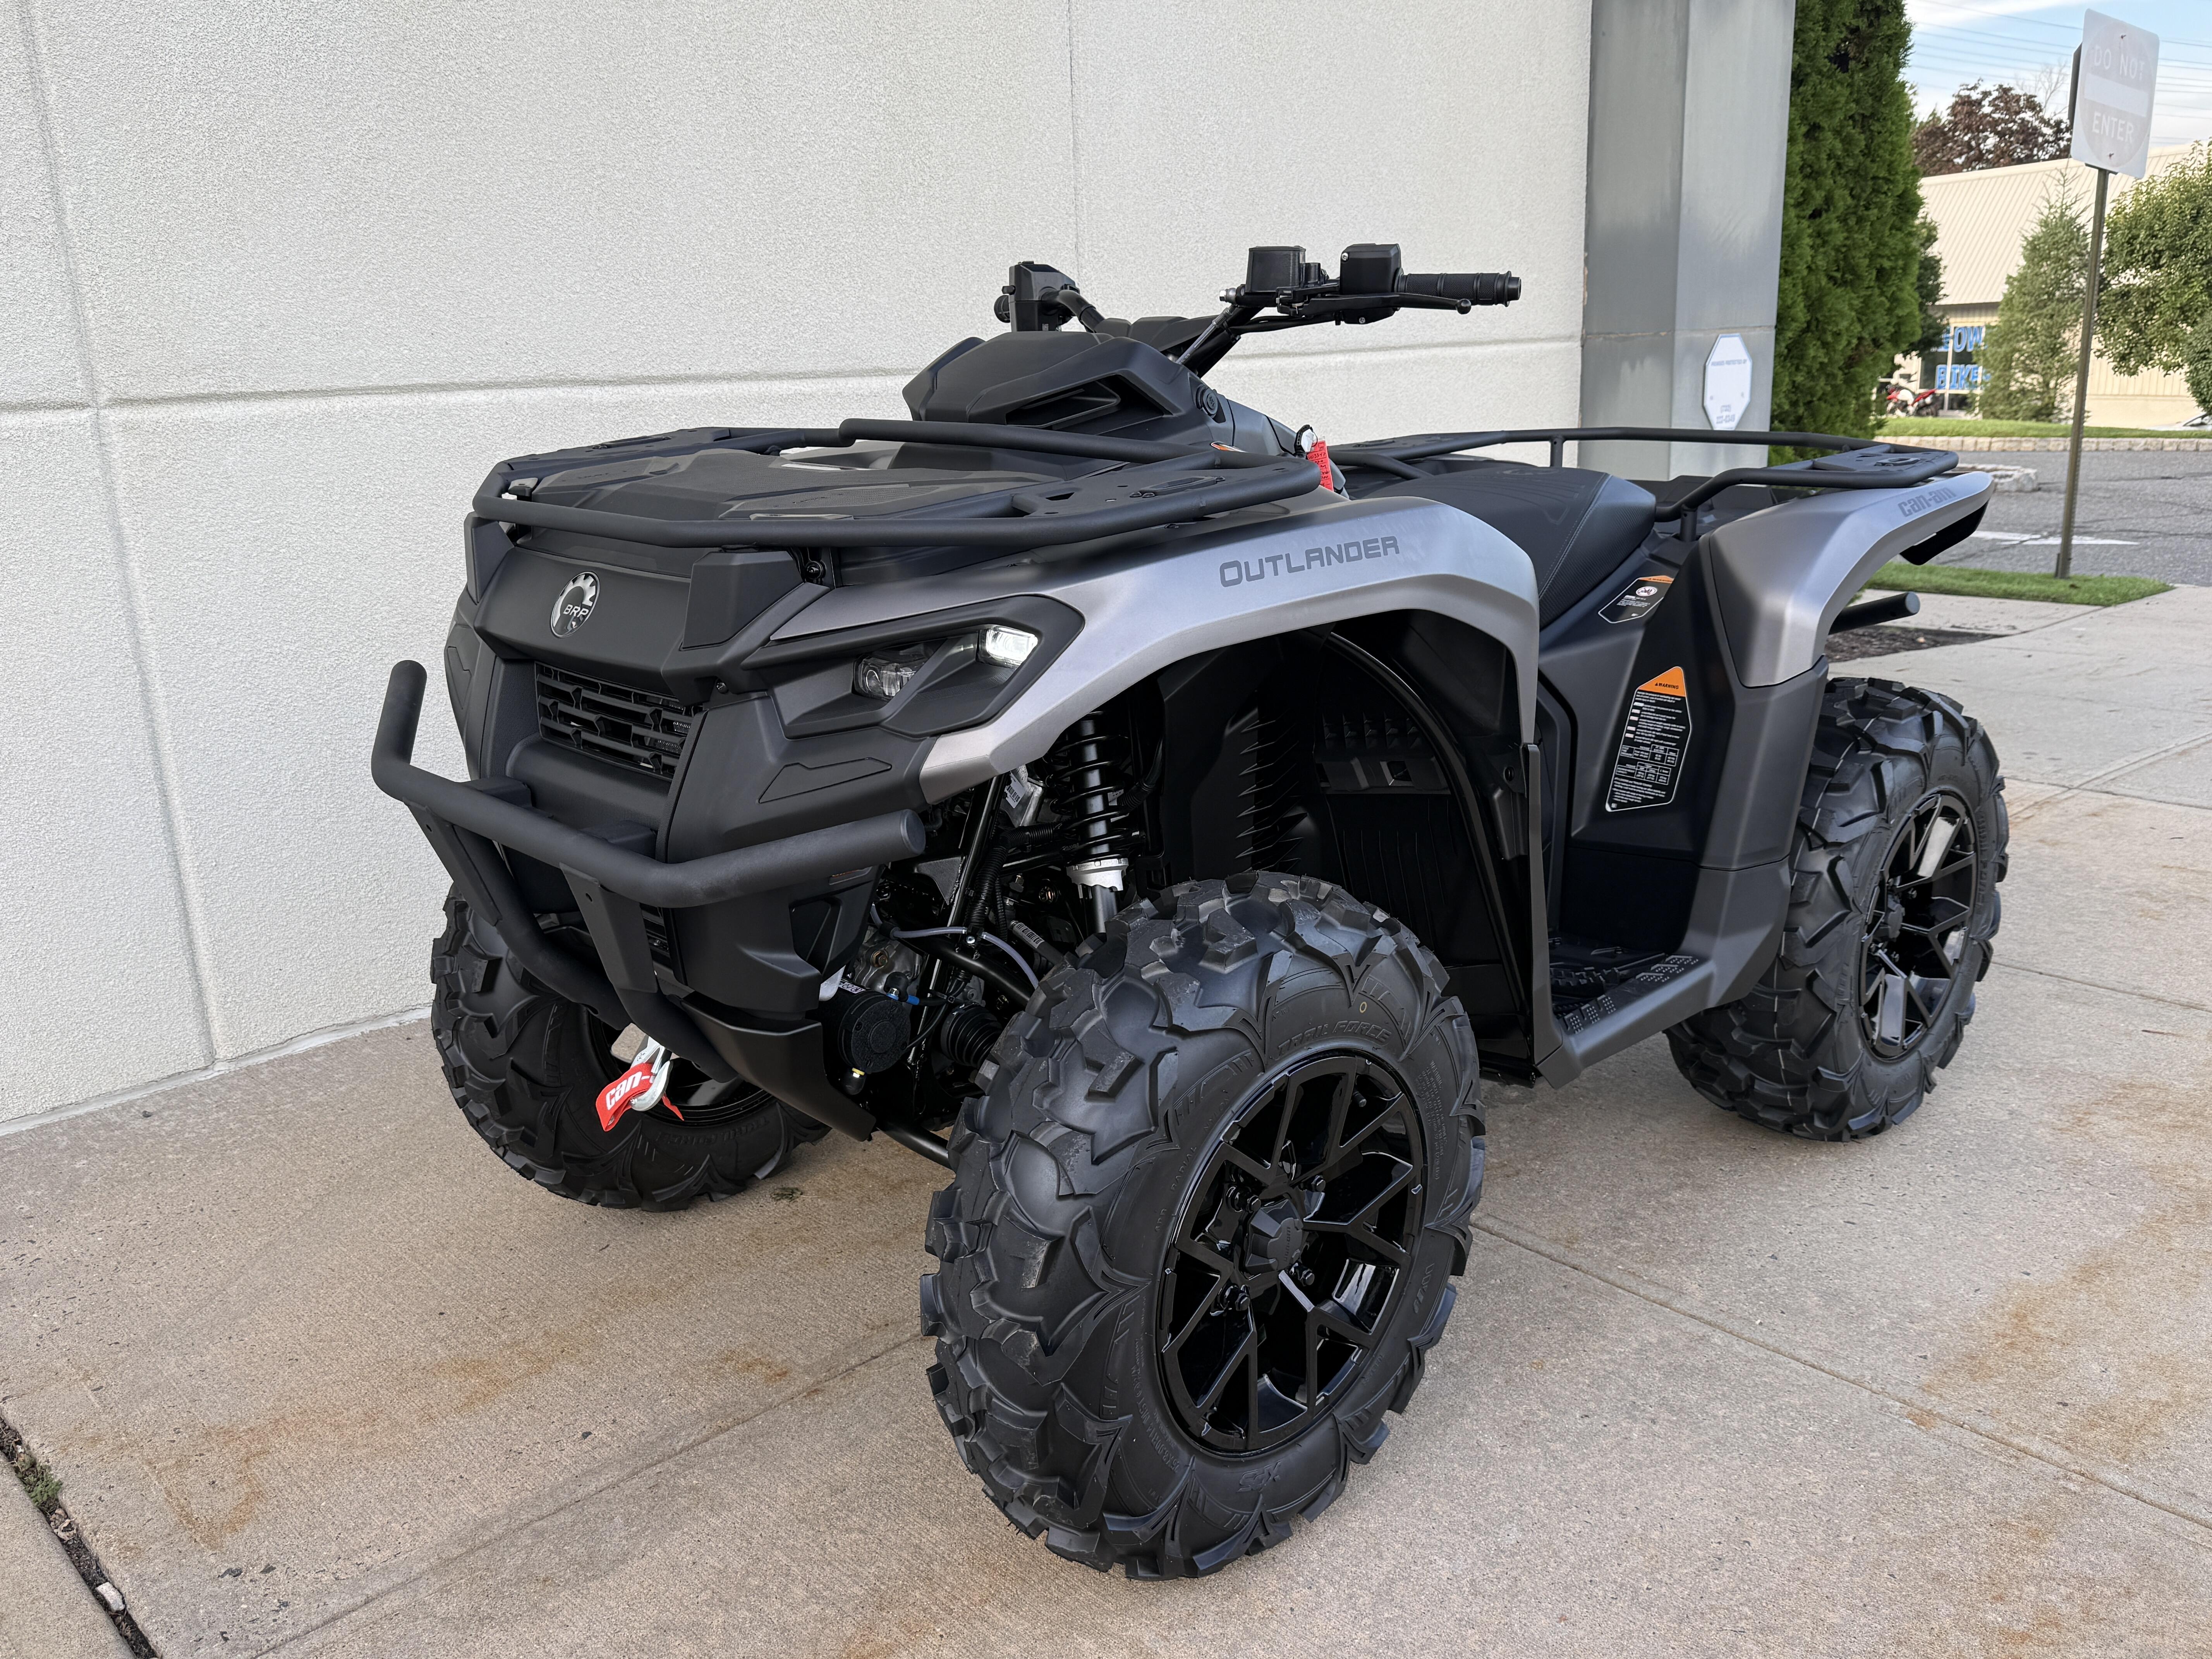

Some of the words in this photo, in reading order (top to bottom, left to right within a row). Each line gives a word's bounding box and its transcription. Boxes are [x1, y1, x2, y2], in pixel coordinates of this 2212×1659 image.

[2093, 46, 2112, 70] DO
[2119, 53, 2145, 81] NOT
[2092, 112, 2134, 143] ENTER
[1898, 487, 1956, 517] can-am
[1219, 536, 1400, 588] OUTLANDER
[563, 604, 589, 618] BRP
[1332, 1020, 1393, 1043] FORCE
[605, 1071, 656, 1111] can-
